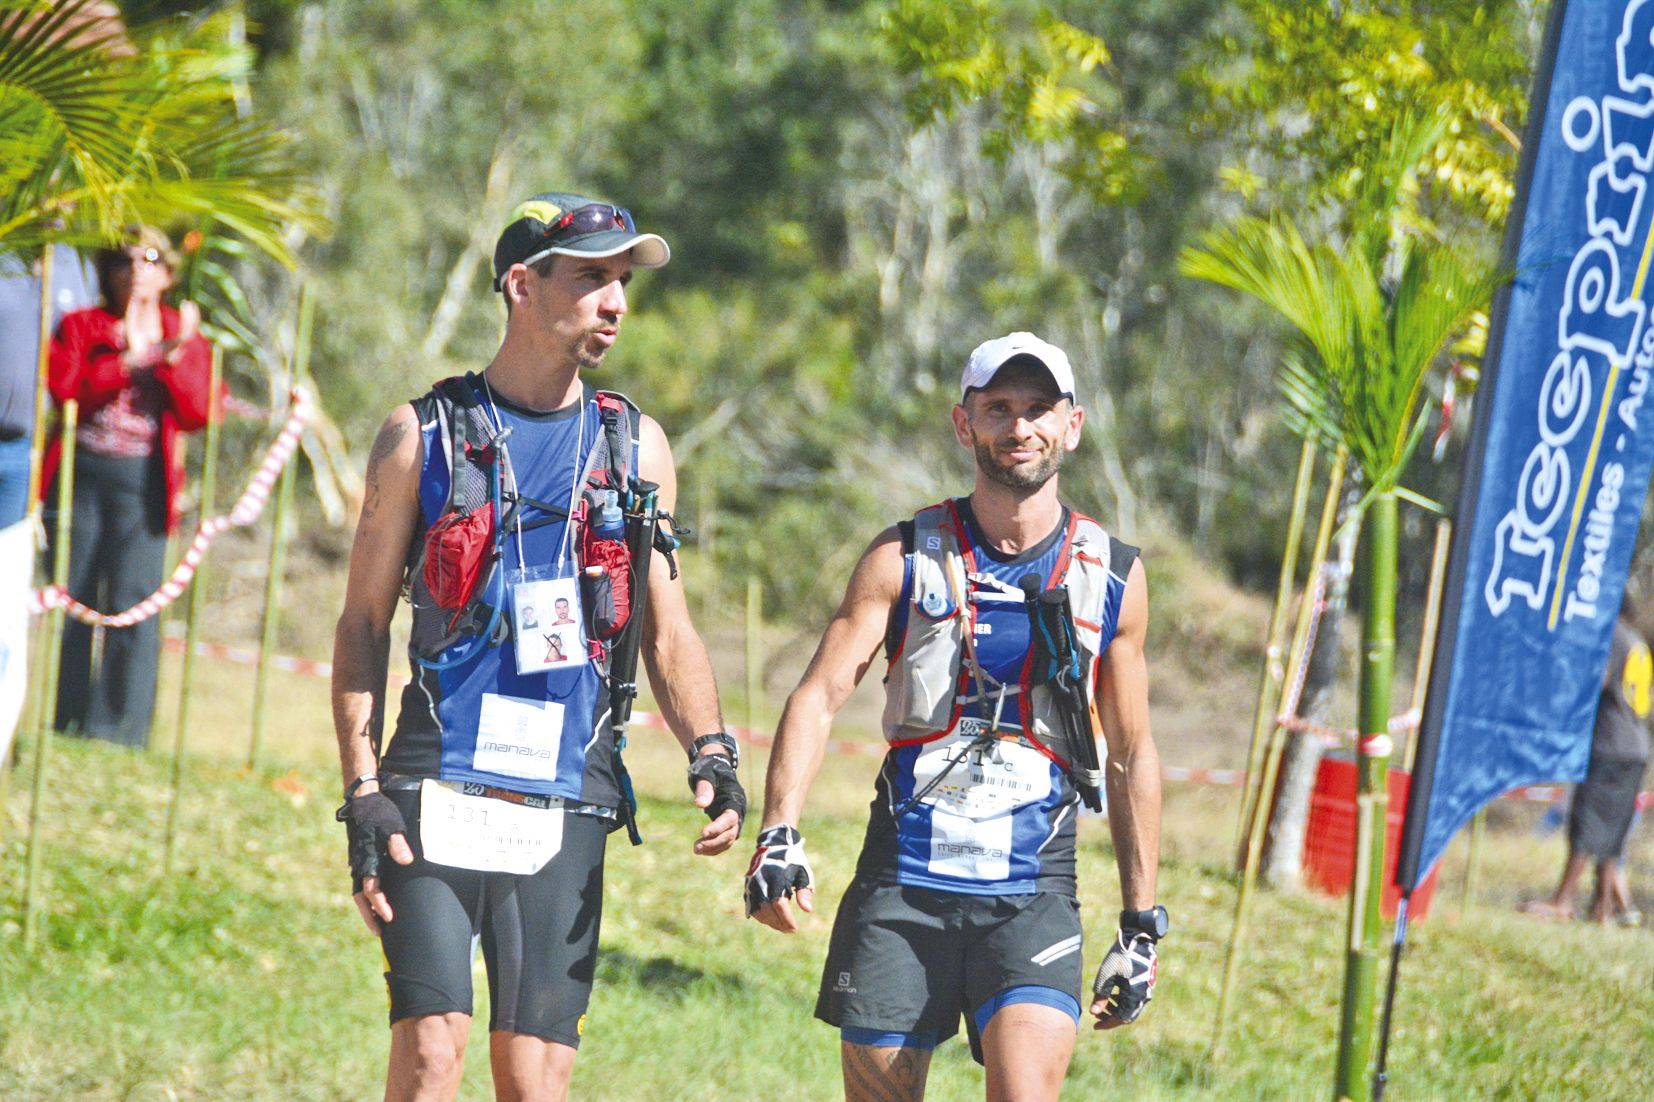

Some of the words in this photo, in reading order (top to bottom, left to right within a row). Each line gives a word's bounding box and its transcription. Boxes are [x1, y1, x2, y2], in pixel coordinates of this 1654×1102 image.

[1564, 460, 1625, 622] Textiles
[1618, 304, 1654, 431] Auto
[483, 741, 551, 759] manava
[448, 804, 492, 826] 131
[938, 843, 1002, 858] manava
